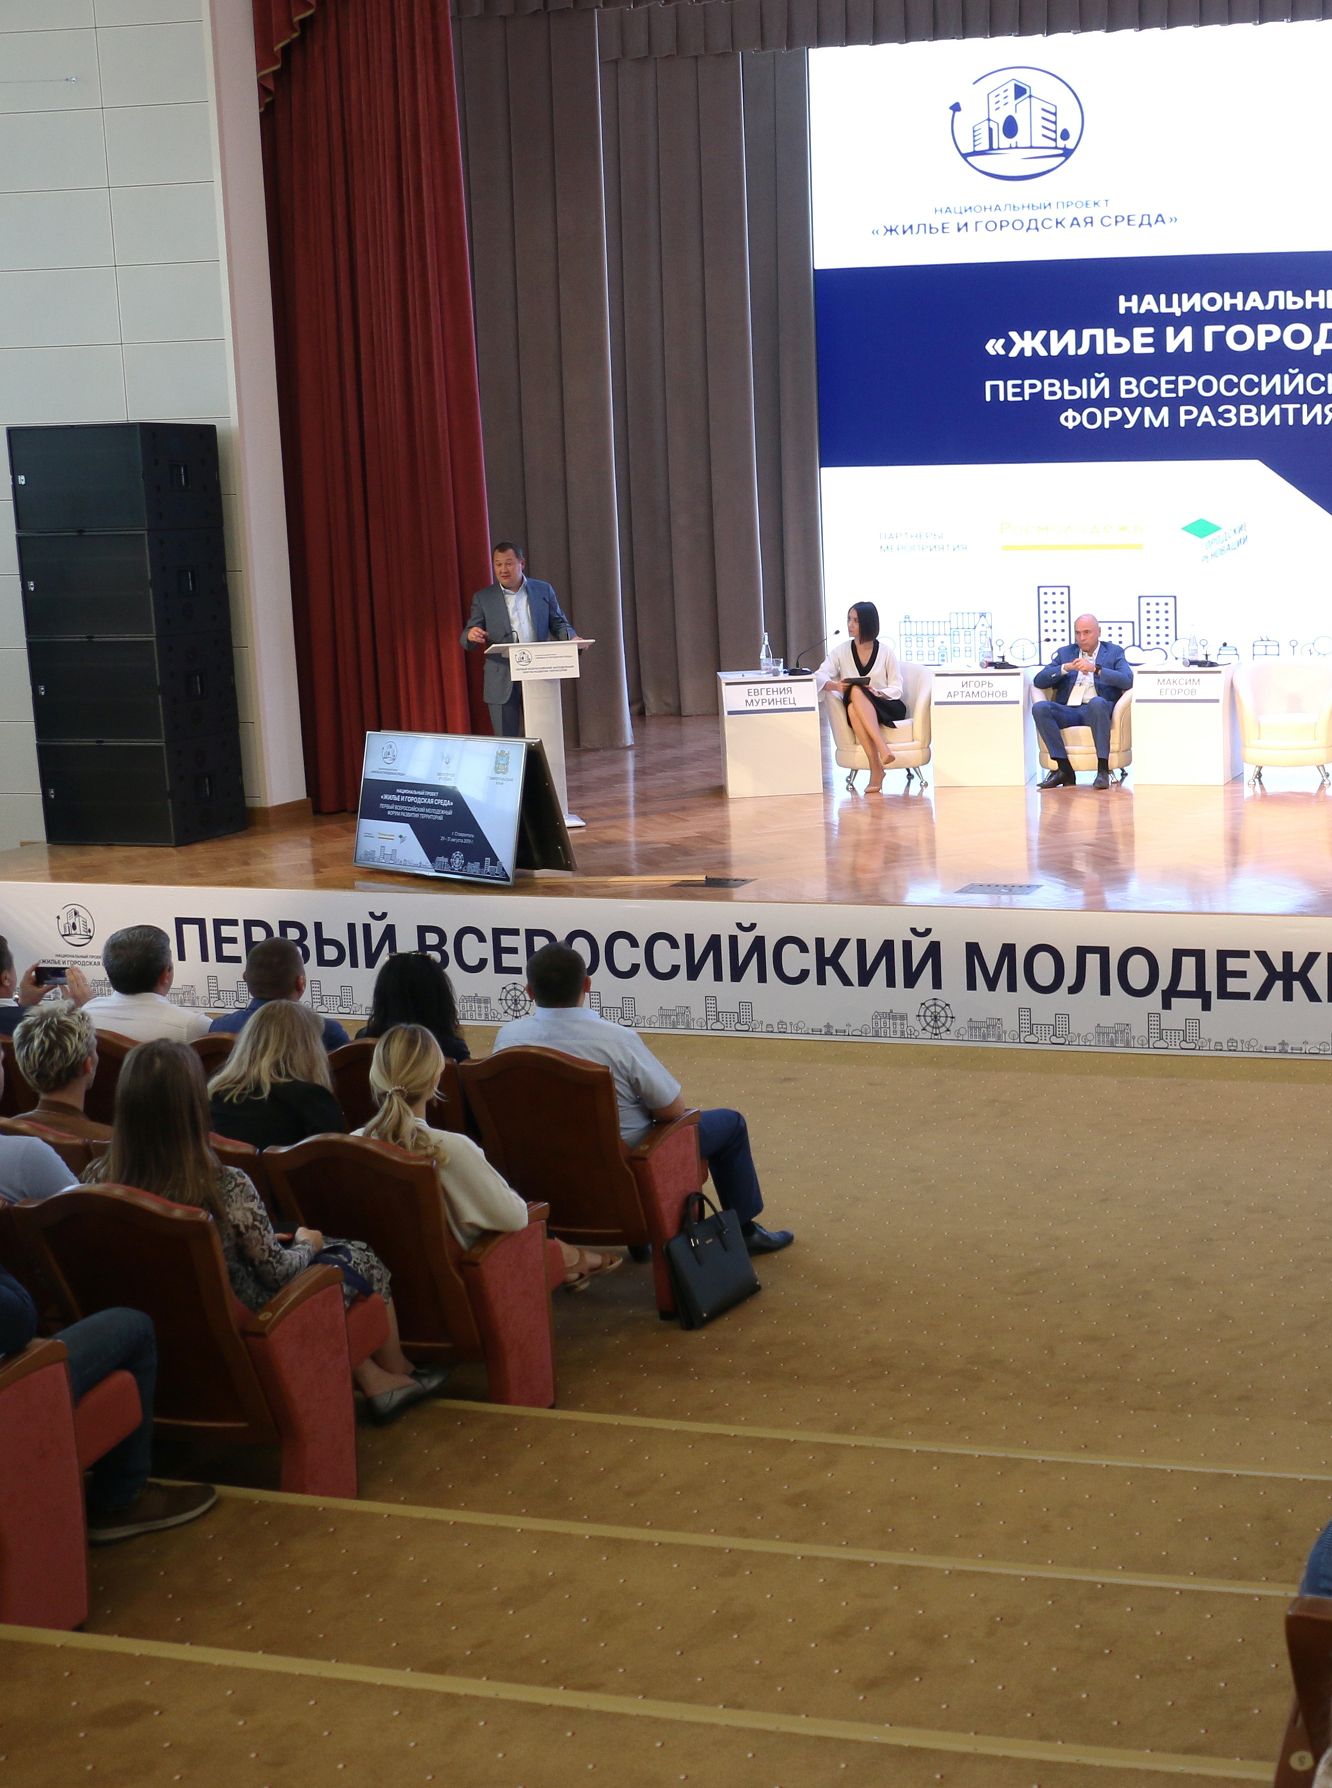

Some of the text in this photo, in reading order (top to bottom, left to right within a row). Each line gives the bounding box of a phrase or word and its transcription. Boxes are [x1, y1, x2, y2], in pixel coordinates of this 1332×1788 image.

[933, 198, 1110, 216] НАЦИОНАЛЬНЫЙ ПРОЕКТ
[871, 213, 1179, 238] «ЖИЛЬЕ И ГОРОДСКАЯ СРЕДА»
[984, 326, 1156, 358] «ЖИЛЬЕ
[1165, 325, 1194, 353] И
[984, 372, 1110, 402] ПЕРВЫЙ
[1059, 405, 1170, 430] ФОРУМ
[961, 680, 994, 688] ИГОРЬ
[1157, 678, 1201, 686] МАКСИМ
[747, 687, 793, 697] ЕВГЕНИЯ
[946, 690, 1008, 698] АРТАМОНОВ
[1159, 688, 1197, 696] ЕГОРОВ
[745, 697, 797, 707] МУРИНЕЦ
[174, 911, 398, 969] ПЕРВЫЙ
